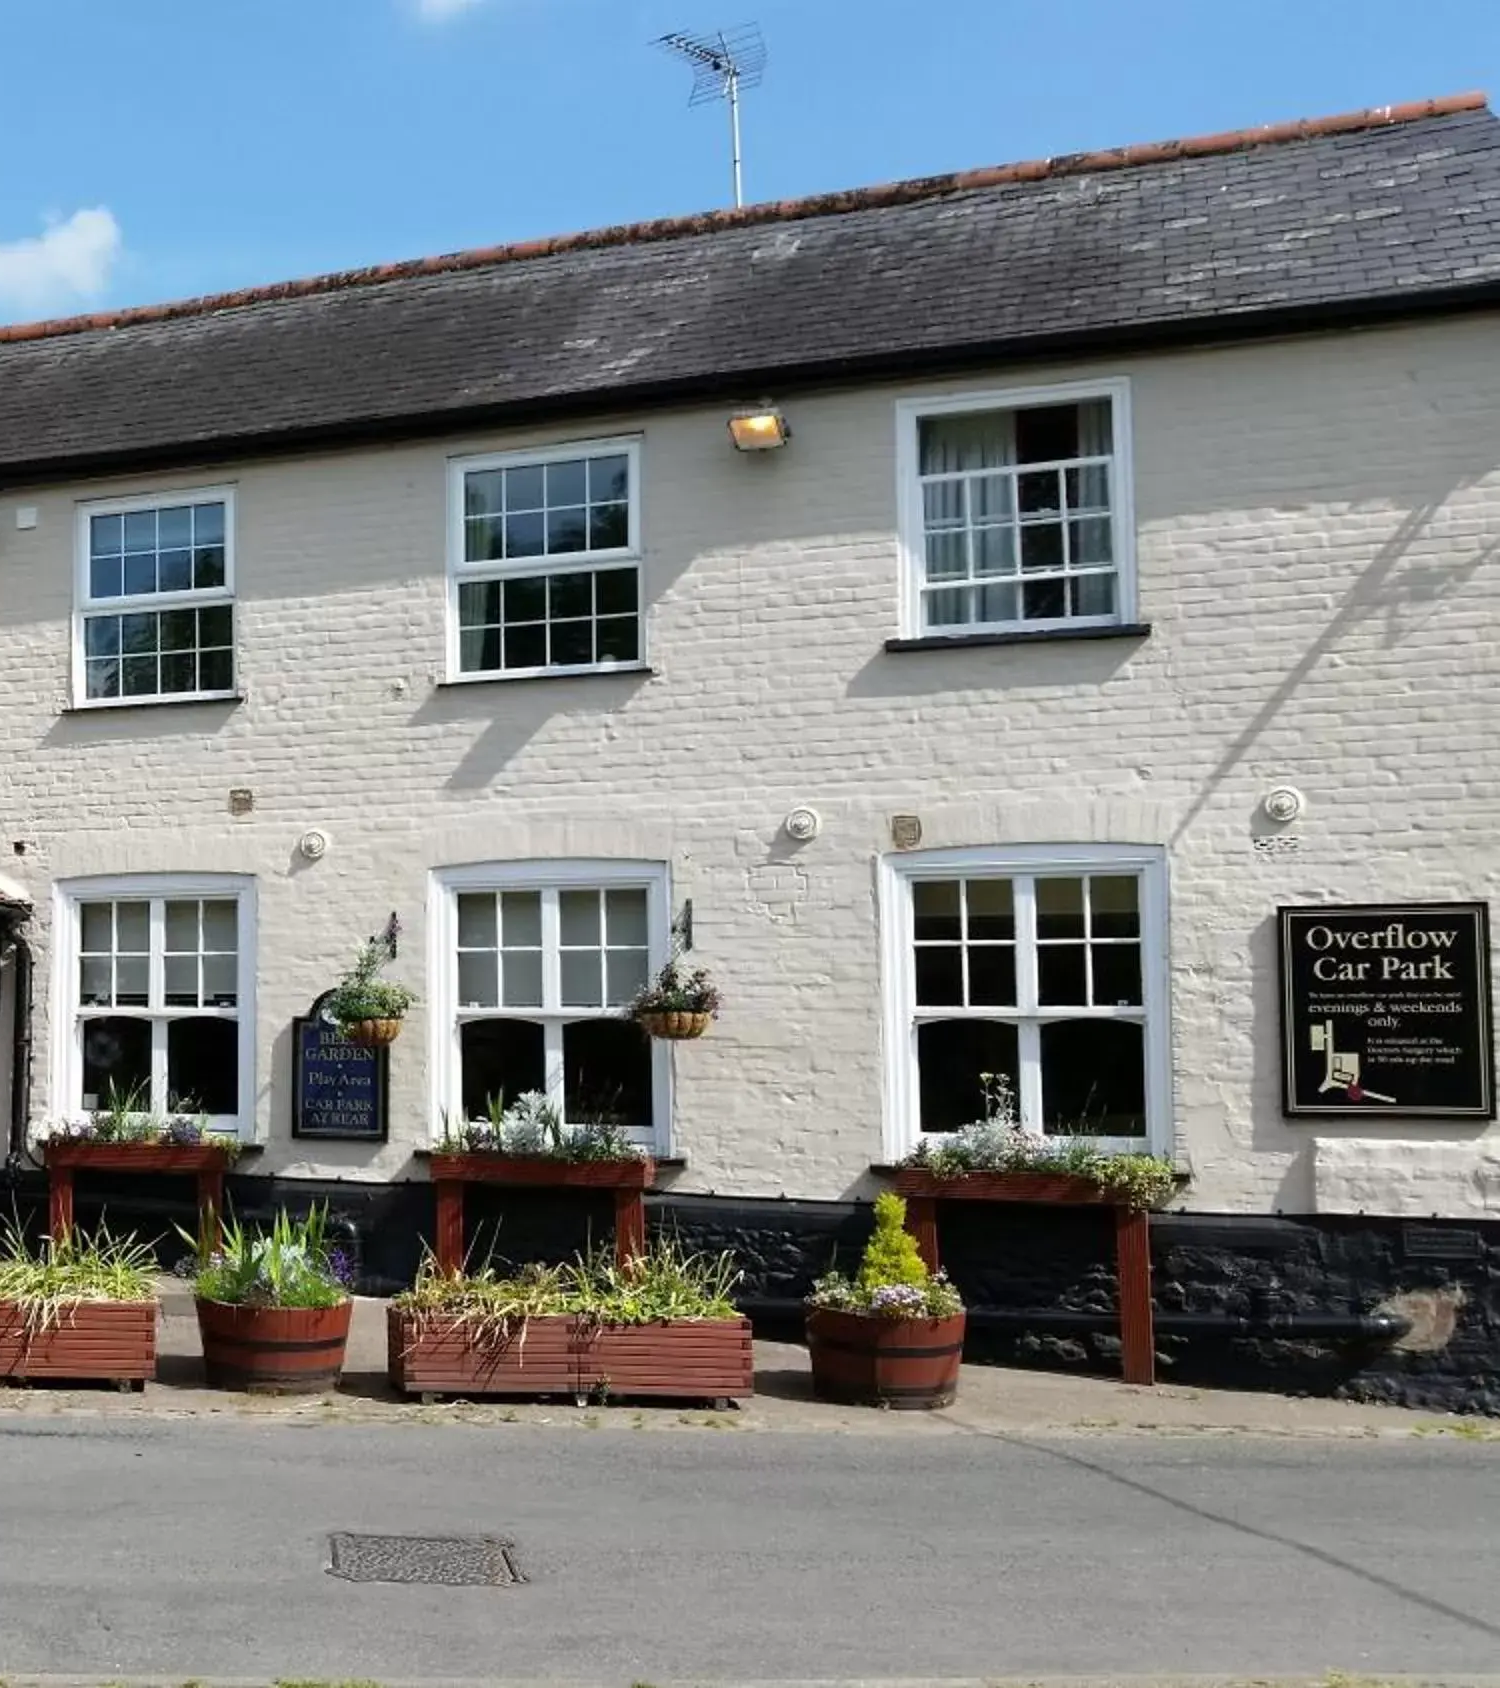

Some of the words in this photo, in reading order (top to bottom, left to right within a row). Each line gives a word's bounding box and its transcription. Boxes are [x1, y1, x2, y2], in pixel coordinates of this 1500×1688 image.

[1306, 923, 1458, 951] Overflow
[1313, 957, 1371, 981] Car
[1381, 954, 1455, 980] Park
[1308, 1002, 1369, 1017] evenings
[1373, 1001, 1386, 1013] &
[1389, 1001, 1463, 1013] weekends
[305, 1047, 374, 1061] GARDEN
[308, 1071, 336, 1086] Play
[340, 1073, 371, 1086] Area
[305, 1099, 334, 1111] CAR
[337, 1099, 373, 1112] PARK
[311, 1112, 328, 1124] AT
[331, 1112, 369, 1126] REAR
